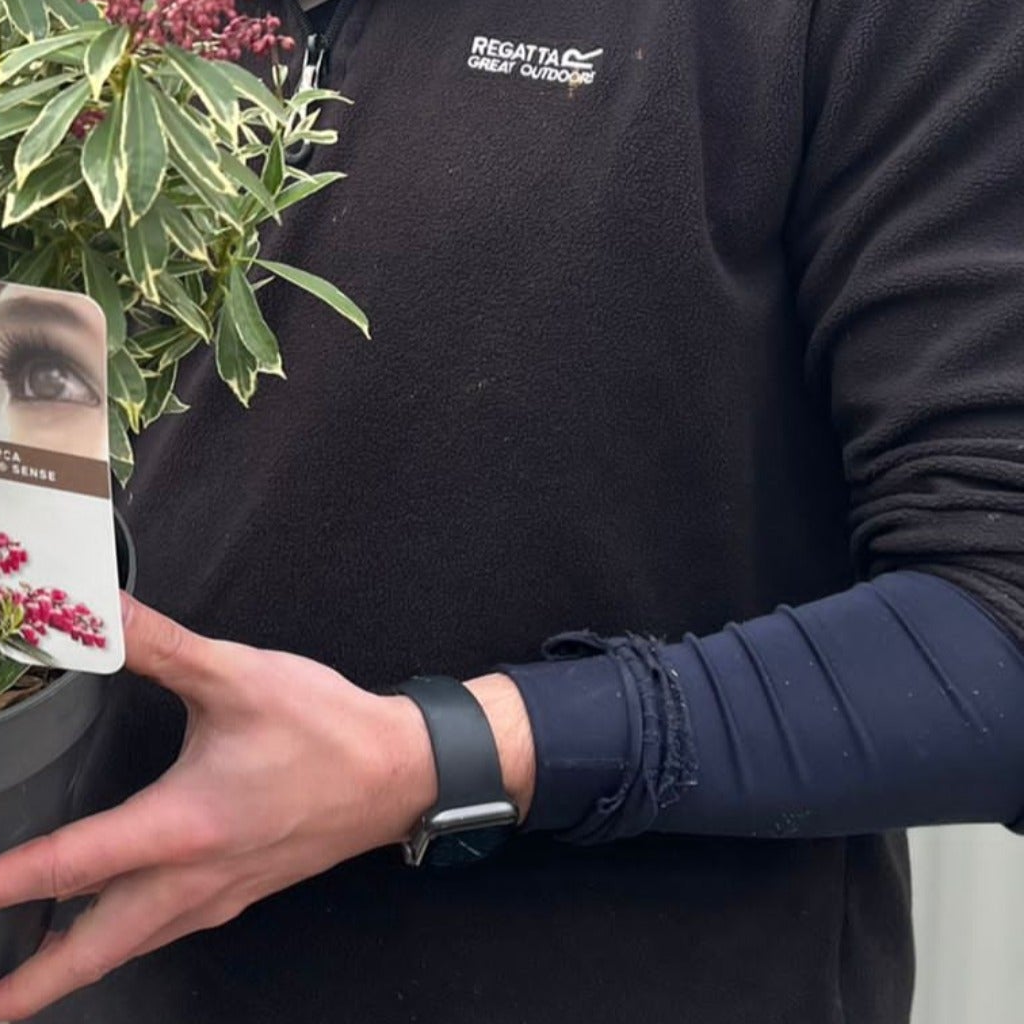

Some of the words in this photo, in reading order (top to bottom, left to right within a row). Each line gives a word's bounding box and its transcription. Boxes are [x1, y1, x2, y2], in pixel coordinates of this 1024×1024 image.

[471, 36, 559, 67] REGATTA
[467, 55, 516, 74] GREAT
[12, 463, 57, 482] SENSE
